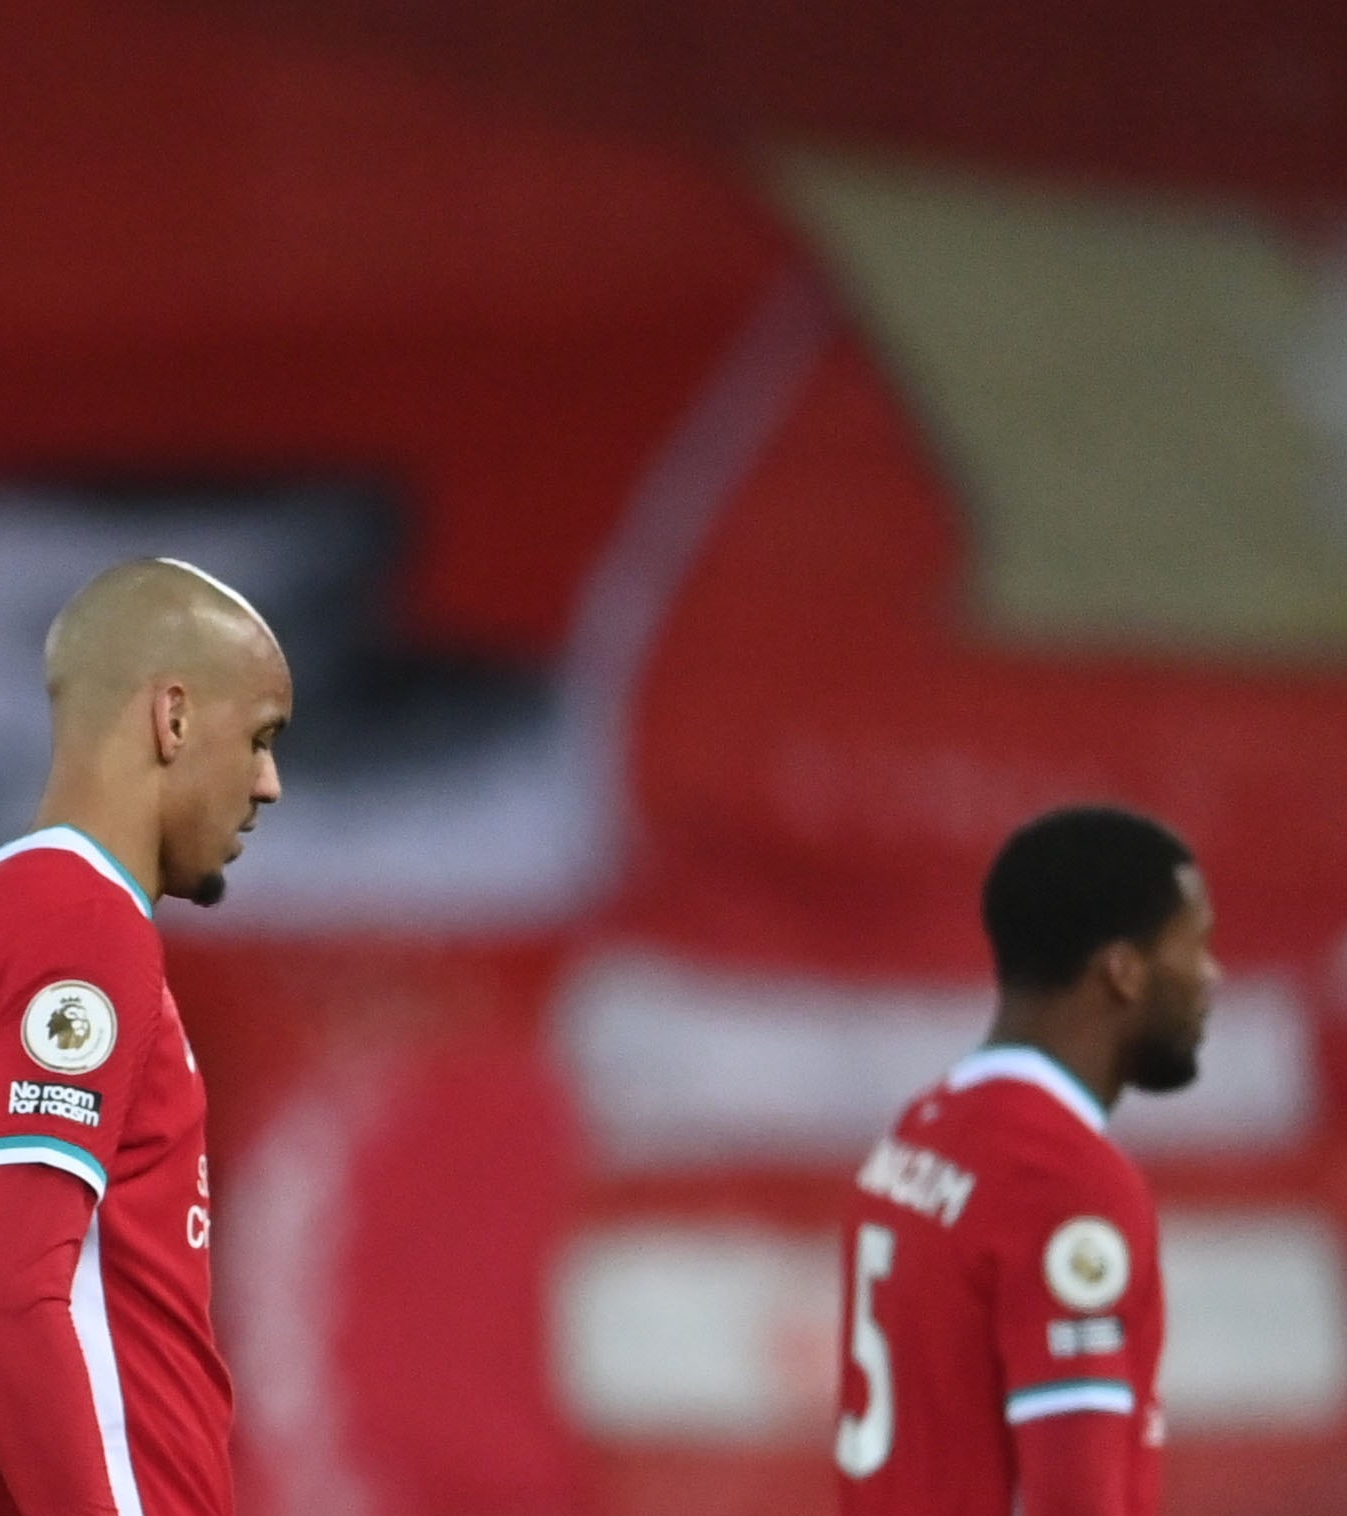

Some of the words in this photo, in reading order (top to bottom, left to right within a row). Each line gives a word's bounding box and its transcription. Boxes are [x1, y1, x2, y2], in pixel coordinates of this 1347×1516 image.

[10, 1081, 40, 1099] No
[43, 1085, 94, 1109] room
[9, 1096, 39, 1114] for
[40, 1100, 100, 1127] racism
[835, 1222, 896, 1479] 5
